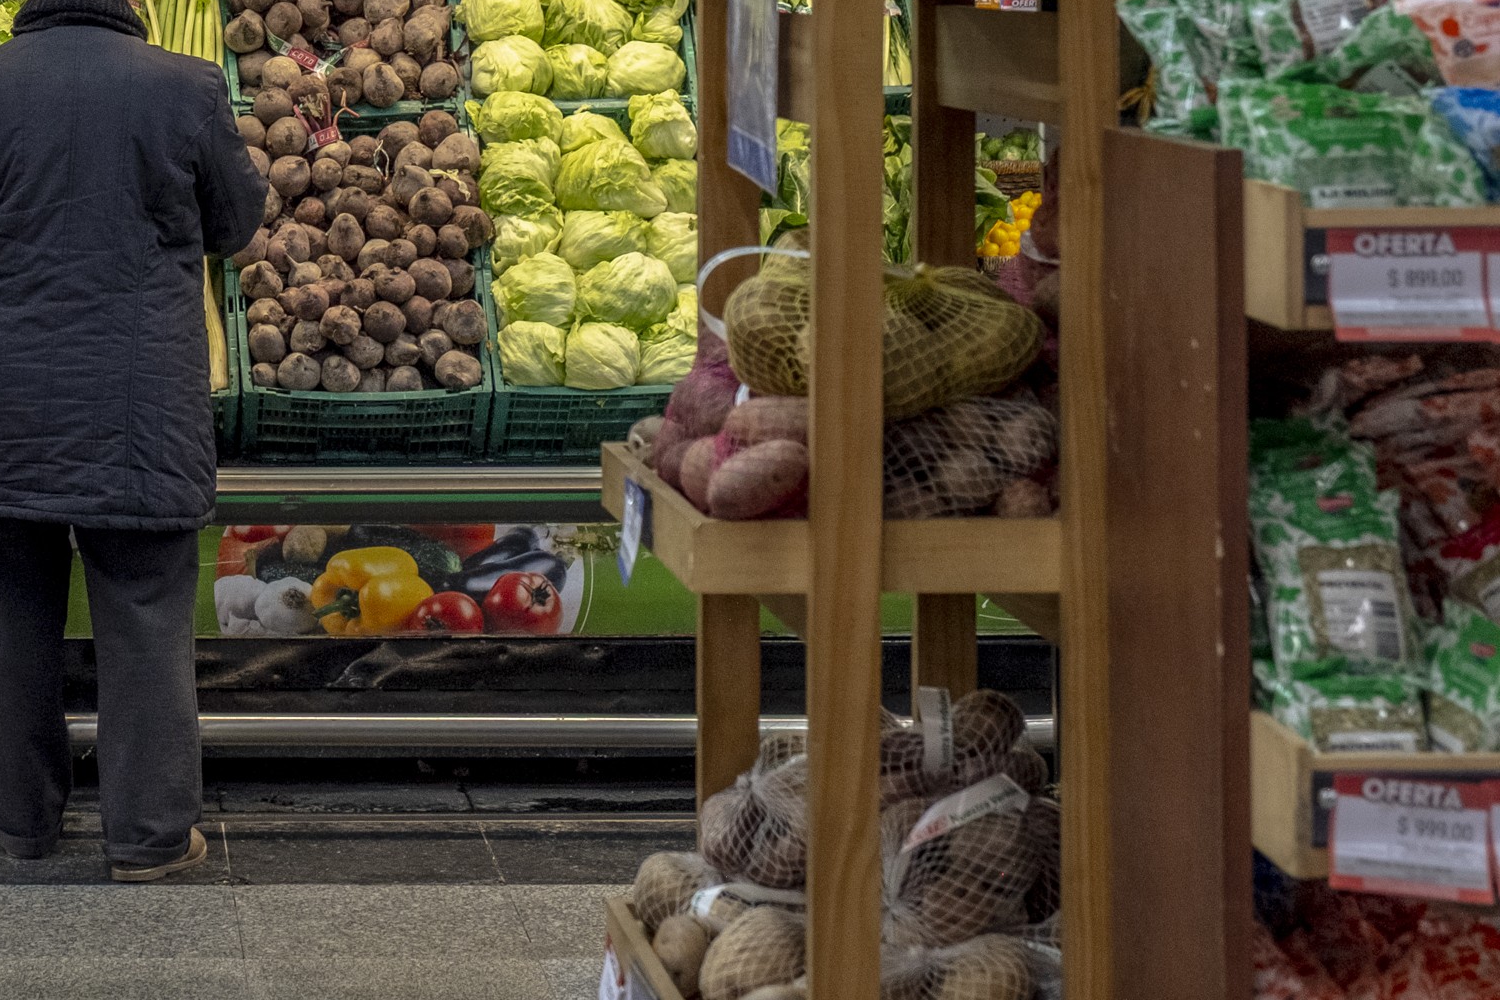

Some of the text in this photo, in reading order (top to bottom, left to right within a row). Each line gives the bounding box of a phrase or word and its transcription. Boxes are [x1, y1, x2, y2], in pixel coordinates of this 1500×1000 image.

[1353, 233, 1456, 257] OFERTA
[1387, 268, 1398, 288] $
[1362, 777, 1463, 811] OFERTA
